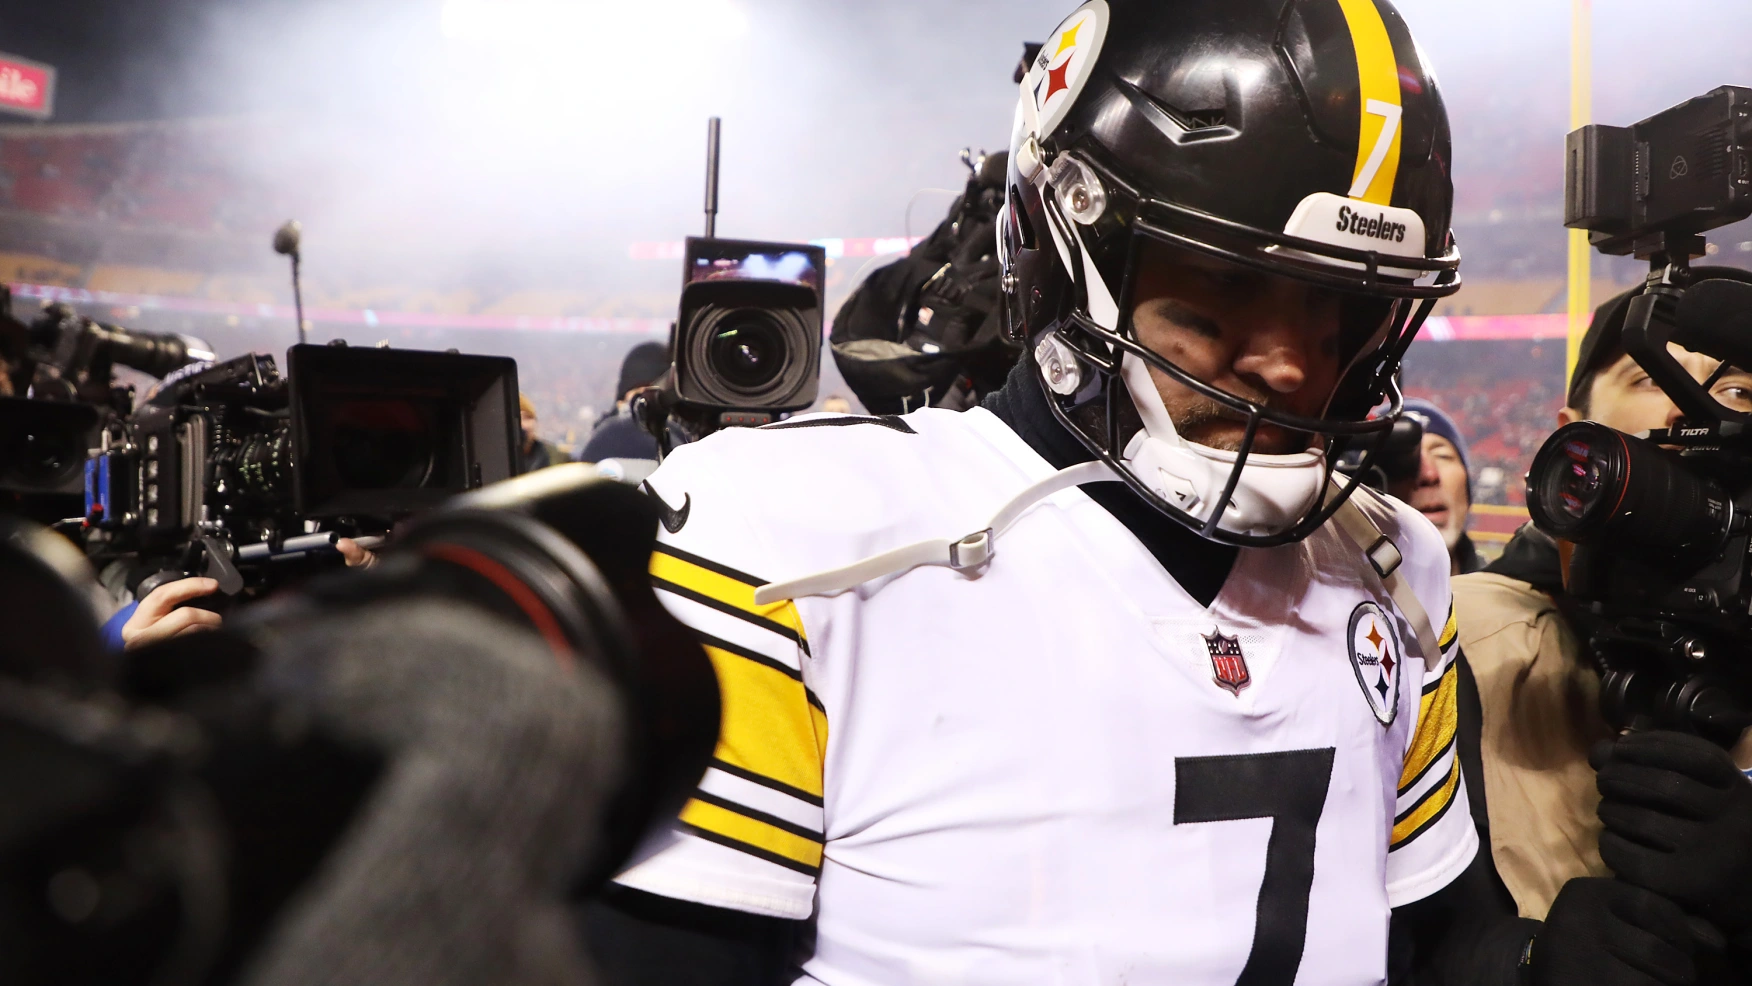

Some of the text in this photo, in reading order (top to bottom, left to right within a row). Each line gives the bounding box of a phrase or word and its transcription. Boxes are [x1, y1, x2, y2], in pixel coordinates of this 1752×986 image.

[1347, 98, 1403, 198] 7
[1336, 205, 1406, 243] Steelers
[1680, 428, 1710, 436] TILTA
[1211, 656, 1248, 683] NFL
[1173, 746, 1337, 986] 7
